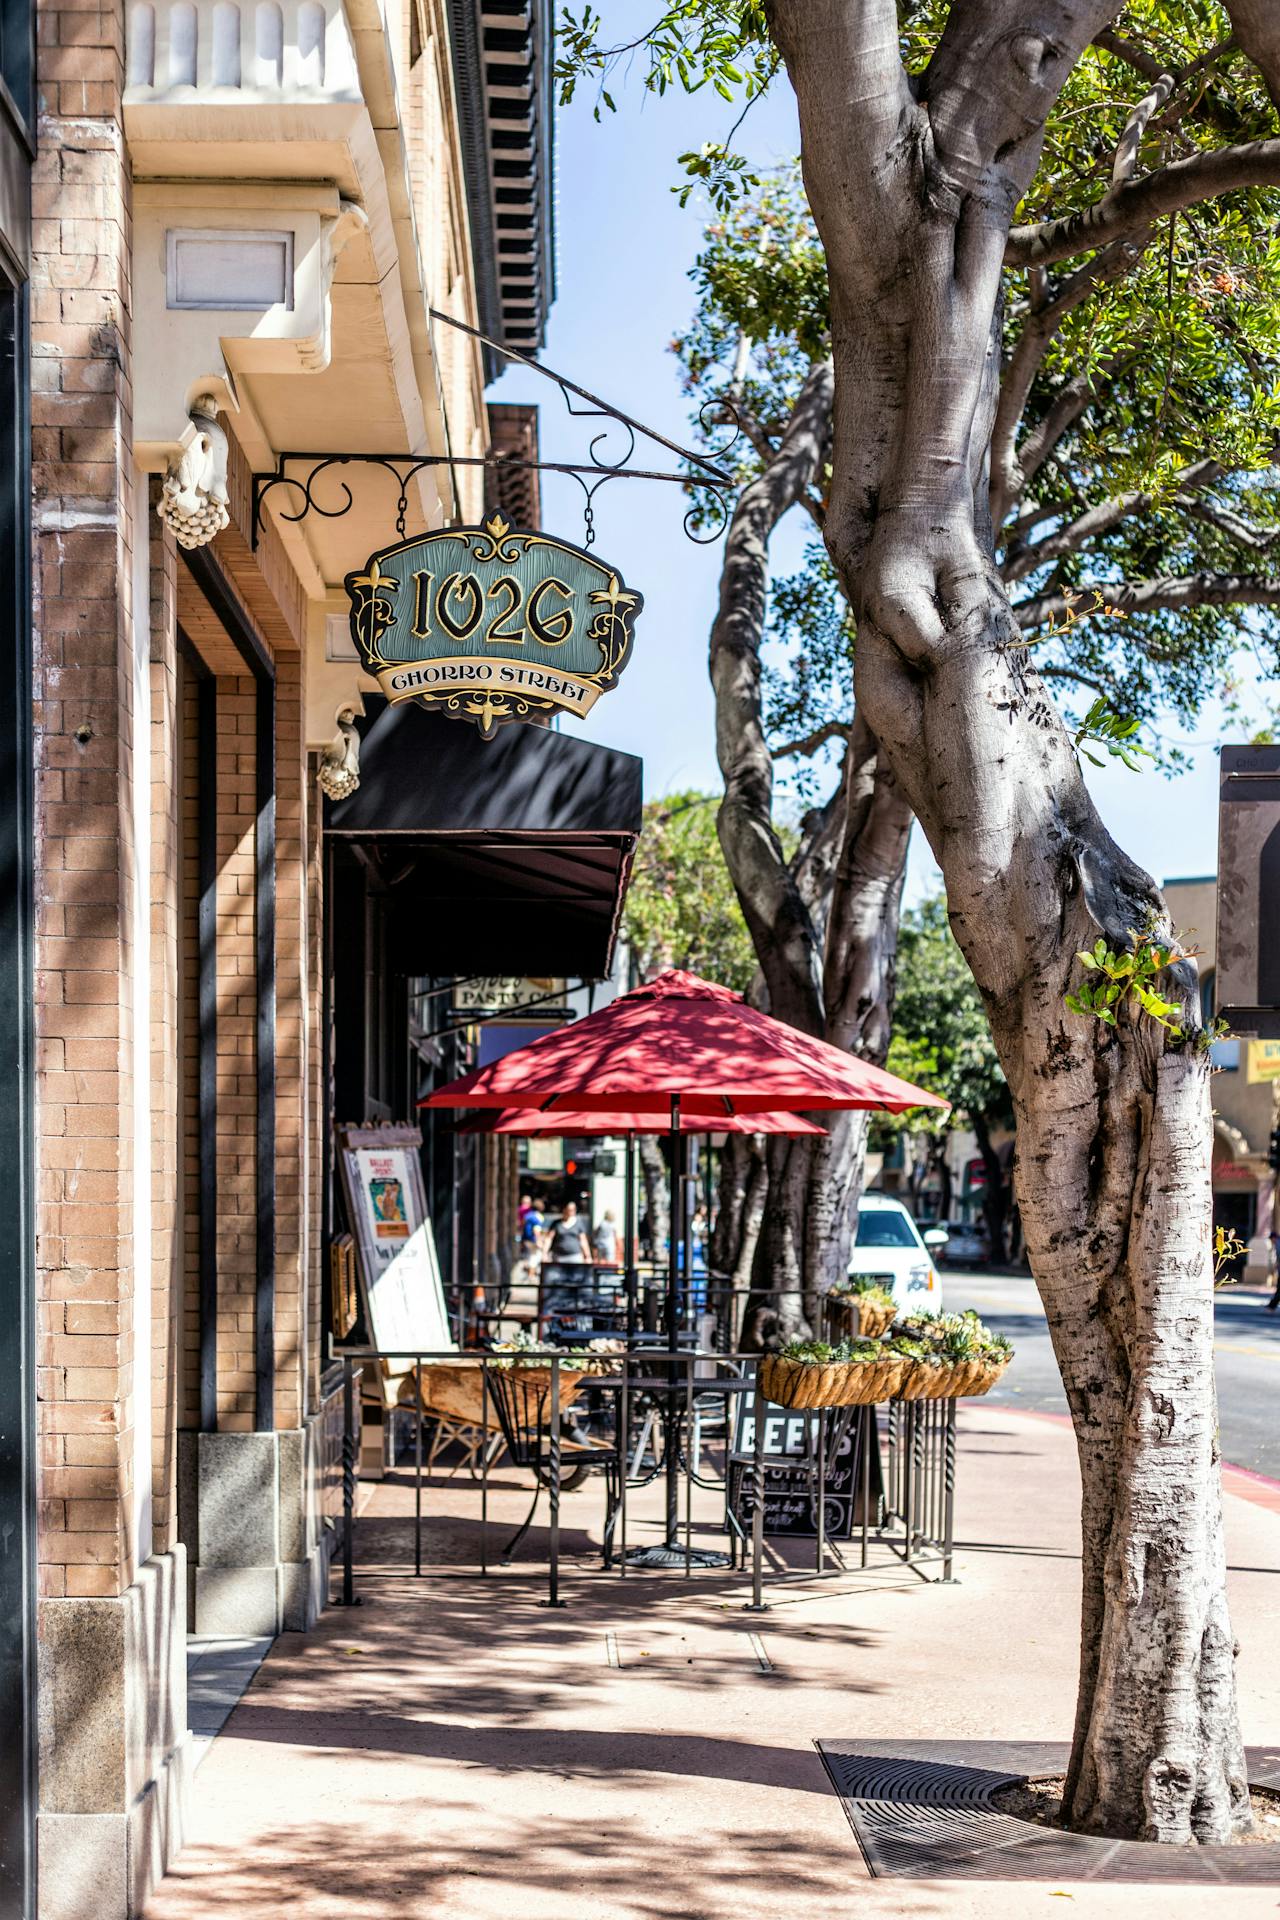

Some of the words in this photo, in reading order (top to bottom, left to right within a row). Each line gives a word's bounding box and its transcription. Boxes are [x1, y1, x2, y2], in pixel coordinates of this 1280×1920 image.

[411, 568, 577, 646] 1026
[391, 664, 493, 690] CHORRO
[499, 666, 590, 702] STREET
[462, 991, 524, 1005] PASTY
